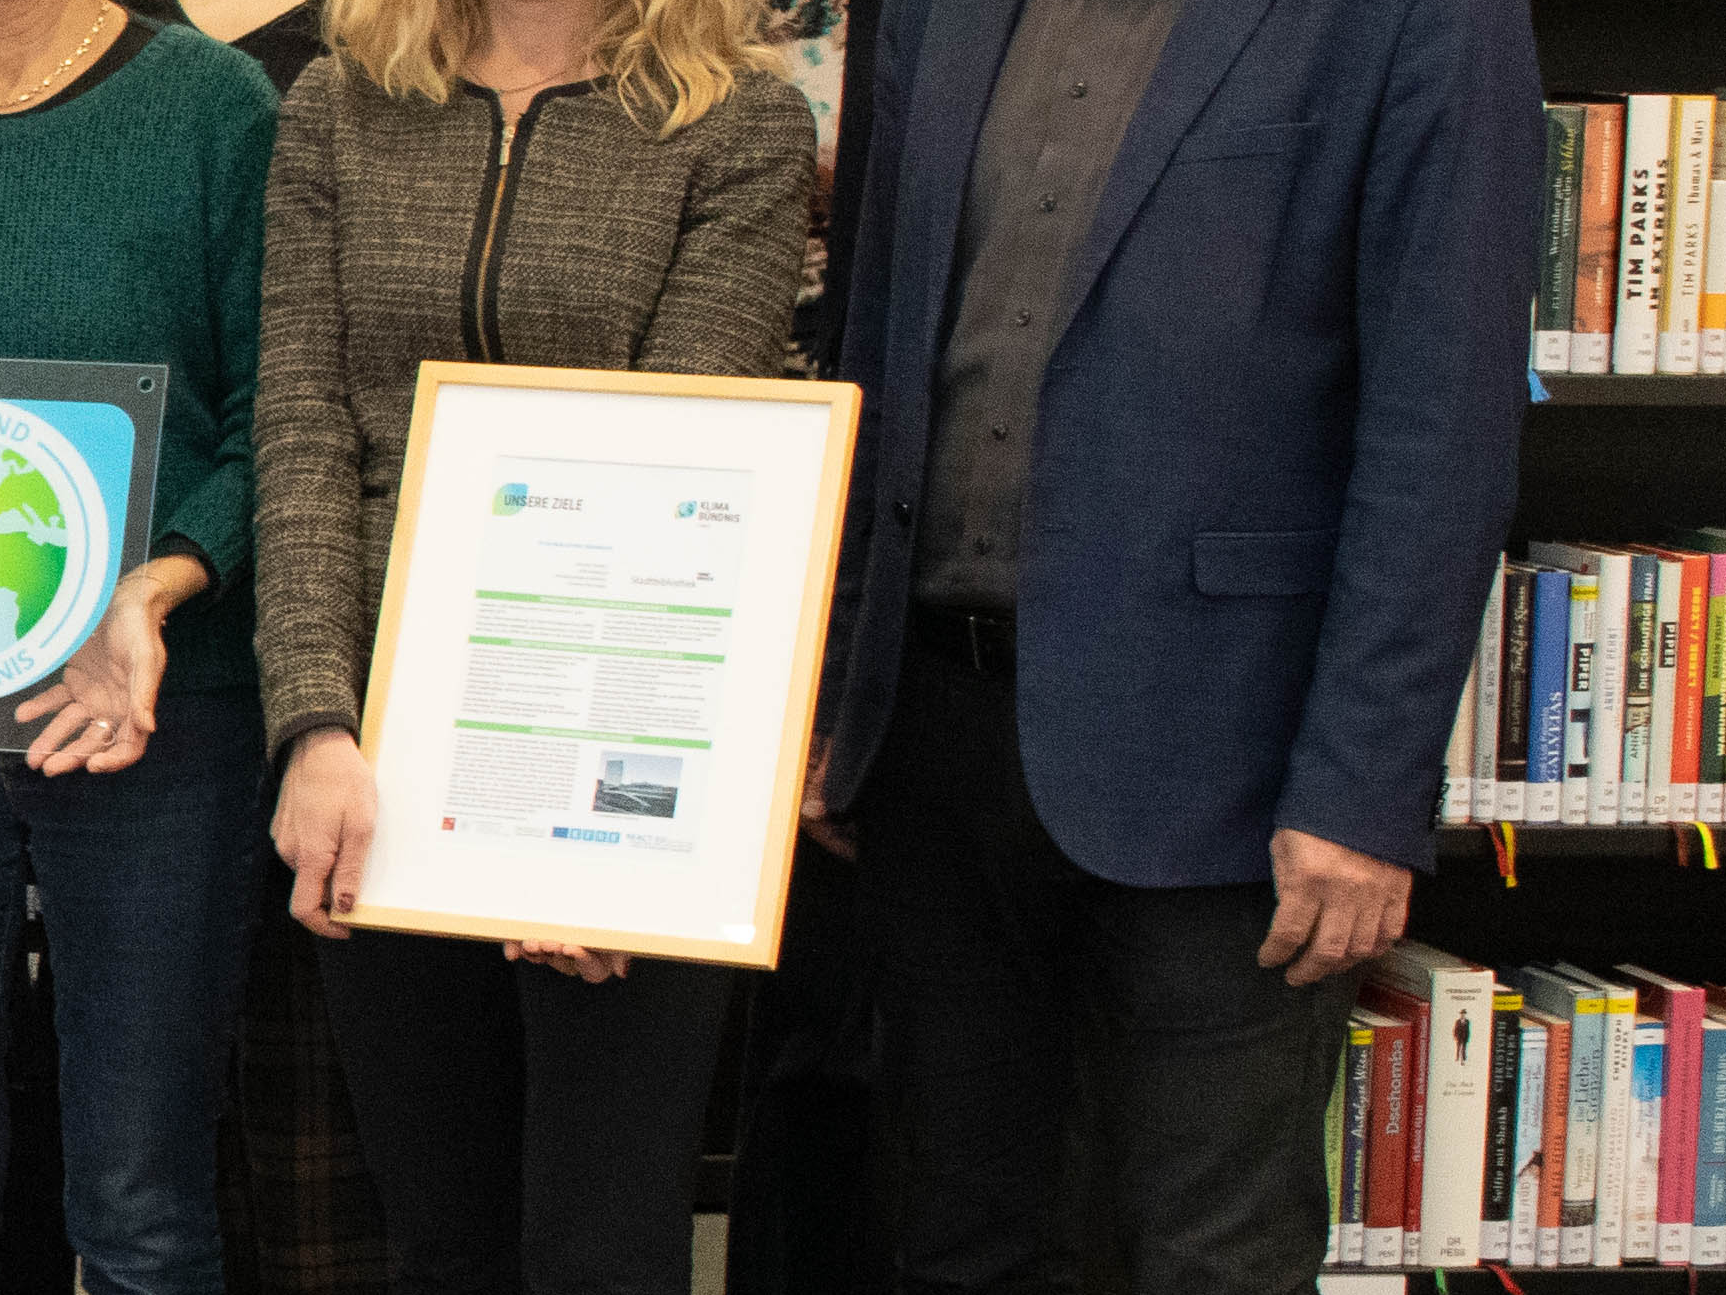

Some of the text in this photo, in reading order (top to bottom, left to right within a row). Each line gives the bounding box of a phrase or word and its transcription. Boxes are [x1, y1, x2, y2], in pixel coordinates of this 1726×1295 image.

[1628, 168, 1649, 300] TIM PARKS
[1682, 222, 1699, 296] TIM PARKS
[504, 494, 584, 511] UNSERE ZIELE
[700, 500, 730, 512] KLIMA
[1578, 646, 1590, 691] PIPER
[1663, 624, 1675, 667] PIPER
[1547, 690, 1563, 782] GALVEIAS
[1386, 1038, 1404, 1137] Dschomba
